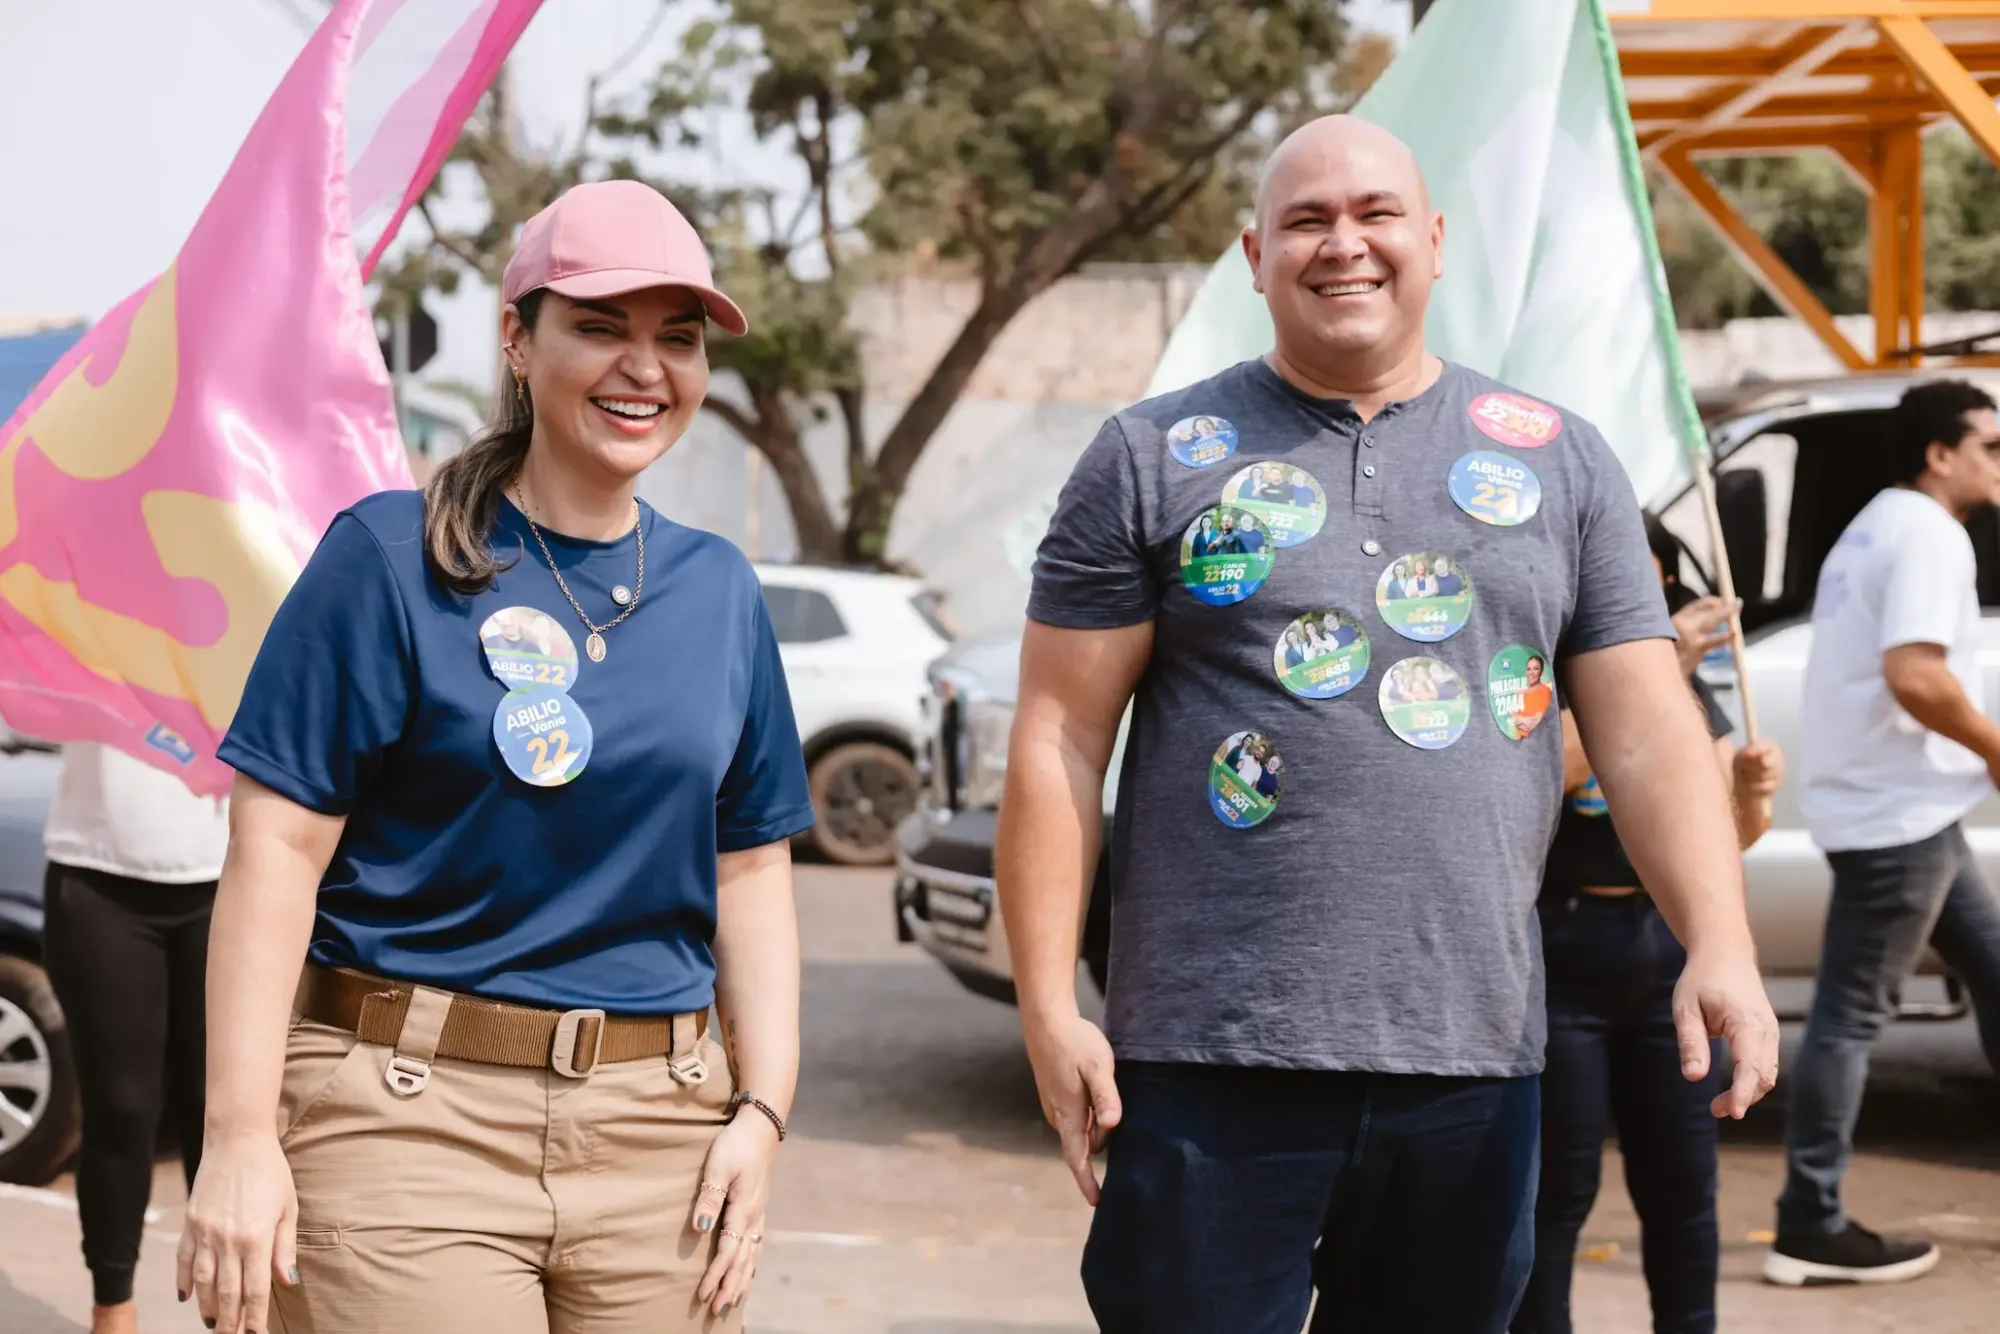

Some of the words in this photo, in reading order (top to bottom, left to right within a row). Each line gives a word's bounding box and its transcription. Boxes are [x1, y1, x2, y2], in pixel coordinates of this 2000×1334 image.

[1467, 459, 1525, 481] ABILIO
[1470, 482, 1518, 516] 22
[1204, 568, 1245, 583] 22190
[491, 660, 534, 675] ABILIO
[535, 662, 568, 687] 22
[506, 698, 562, 733] ABILIO
[526, 729, 572, 776] 22
